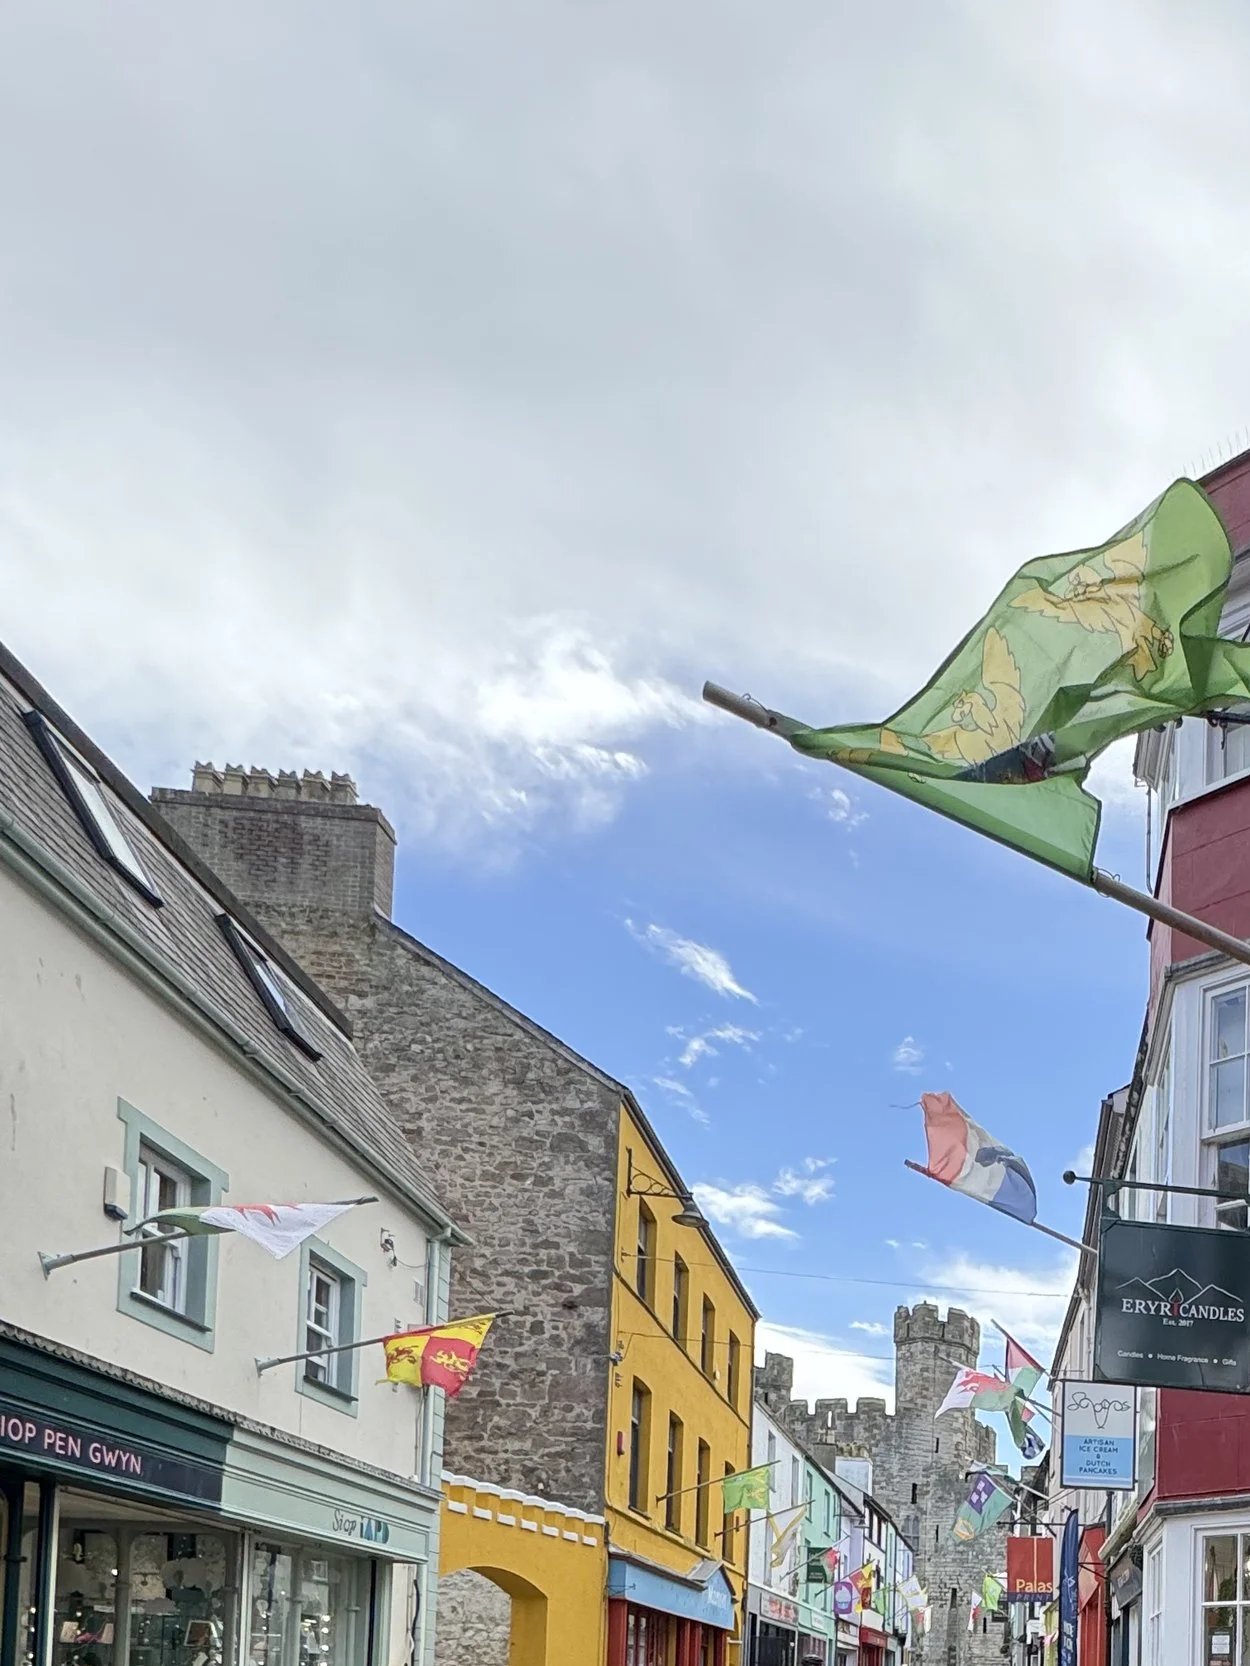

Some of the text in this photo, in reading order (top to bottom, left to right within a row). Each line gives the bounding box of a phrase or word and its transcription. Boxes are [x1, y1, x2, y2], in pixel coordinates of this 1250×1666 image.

[1180, 1304, 1245, 1322] CANDLES
[1117, 1350, 1237, 1366] Candles Home Fragrance Gifts
[44, 1428, 82, 1459] PEN
[89, 1442, 142, 1475] GWYN
[1079, 1445, 1092, 1453] ICE
[1079, 1466, 1117, 1475] PANCAKES
[333, 1508, 357, 1536] Siop
[1016, 1579, 1053, 1593] Palas
